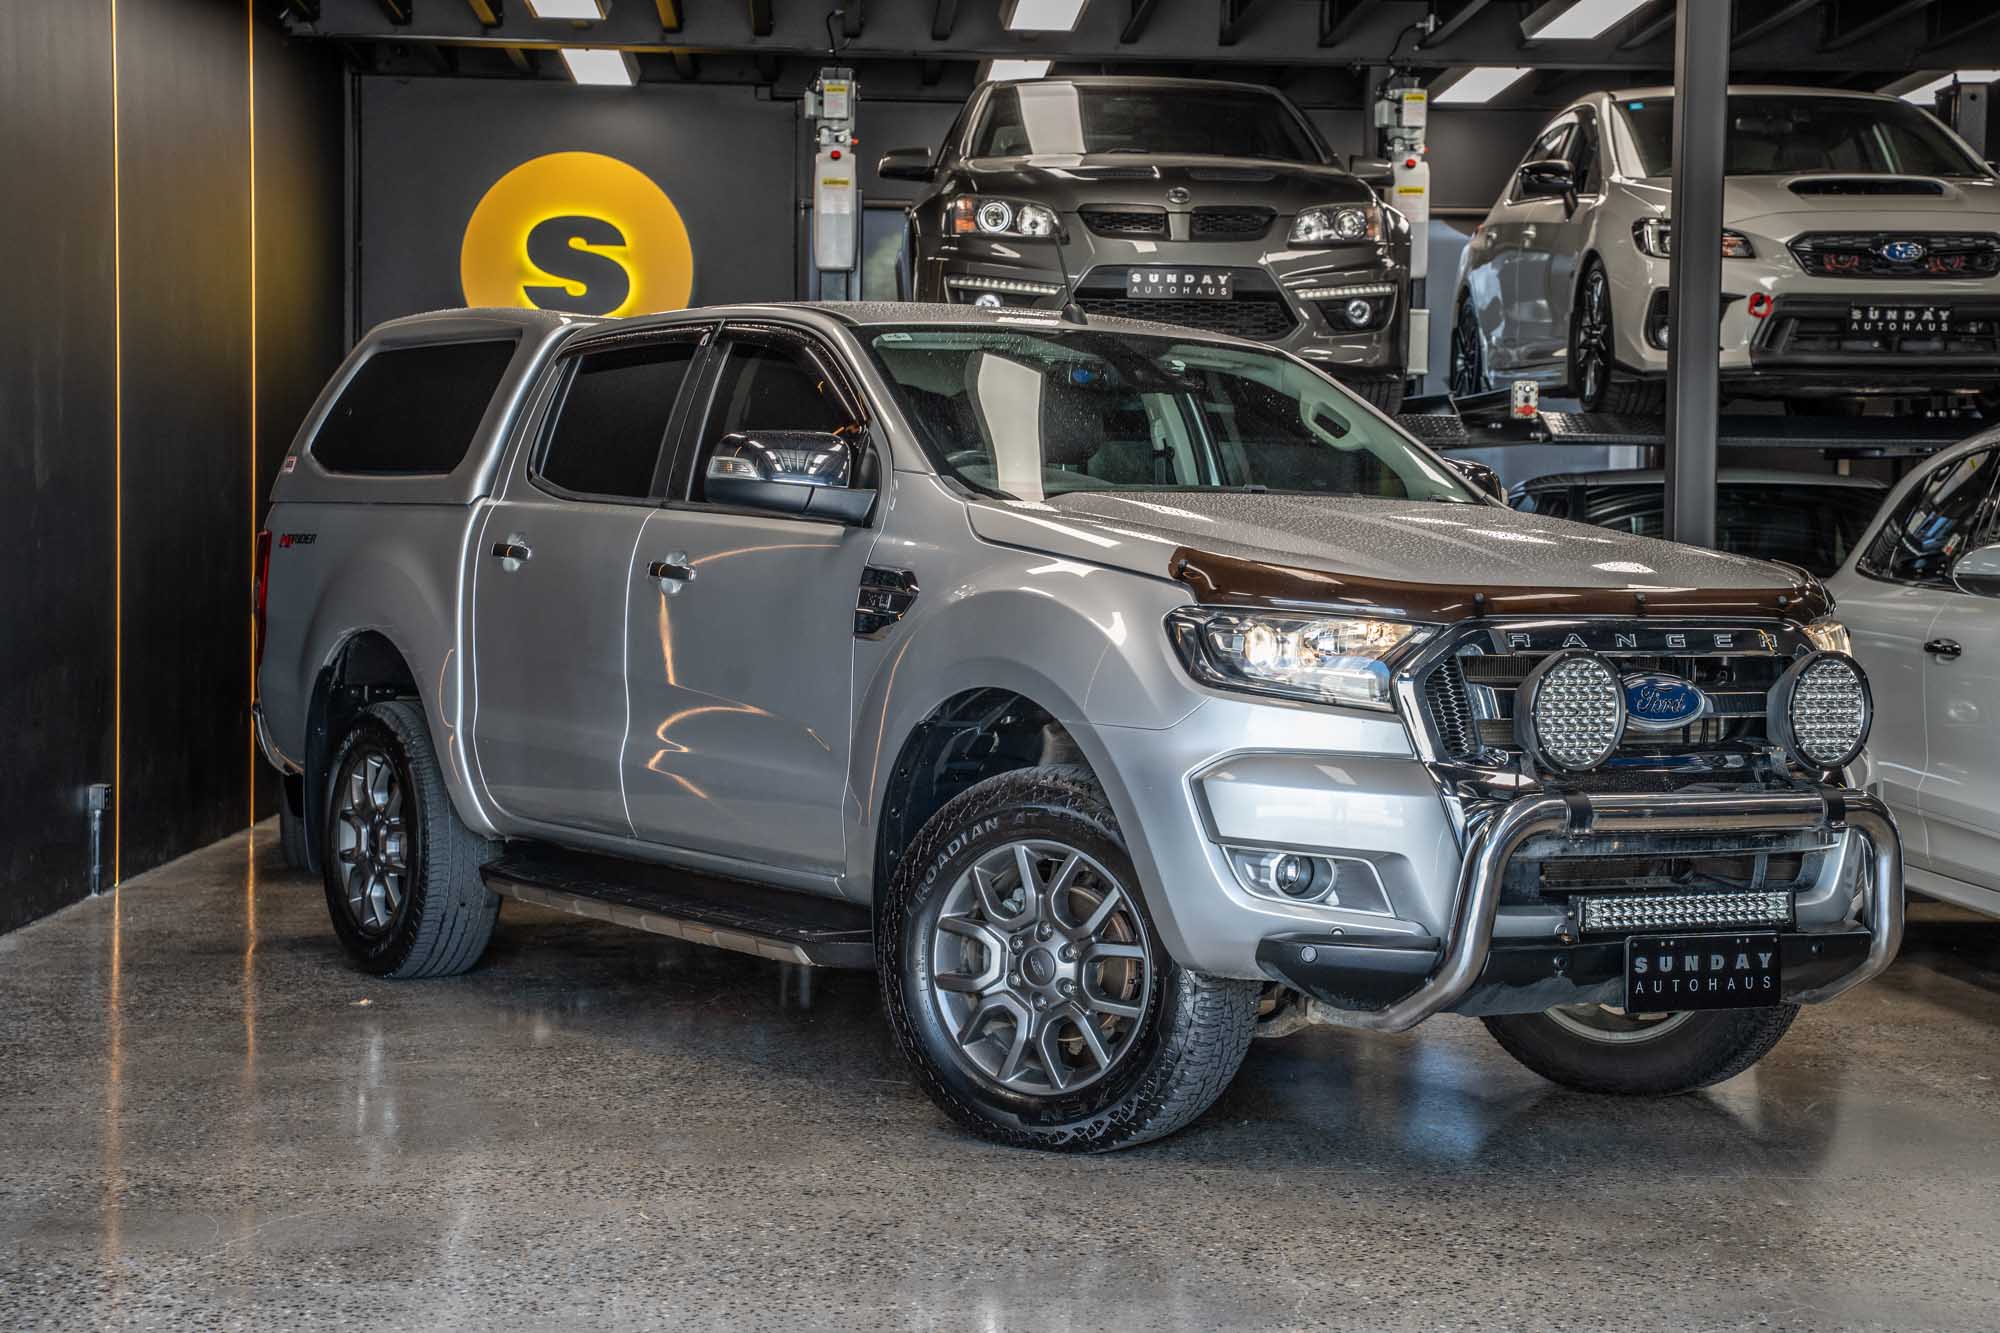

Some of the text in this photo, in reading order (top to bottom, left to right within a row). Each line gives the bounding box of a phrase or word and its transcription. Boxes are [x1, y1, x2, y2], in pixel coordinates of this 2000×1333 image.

[523, 216, 629, 315] S
[1131, 273, 1228, 285] SUNDAY
[1131, 286, 1228, 296] AUTOHAUS
[1851, 310, 1950, 320] SUNDAY
[1851, 322, 1948, 331] AUTOHAUS
[1507, 632, 1778, 649] RANGER
[1635, 684, 1687, 714] Ford
[914, 816, 999, 905] ROADIAN
[1634, 952, 1773, 974] SUNDAY
[1634, 975, 1772, 995] AUTOHAUS
